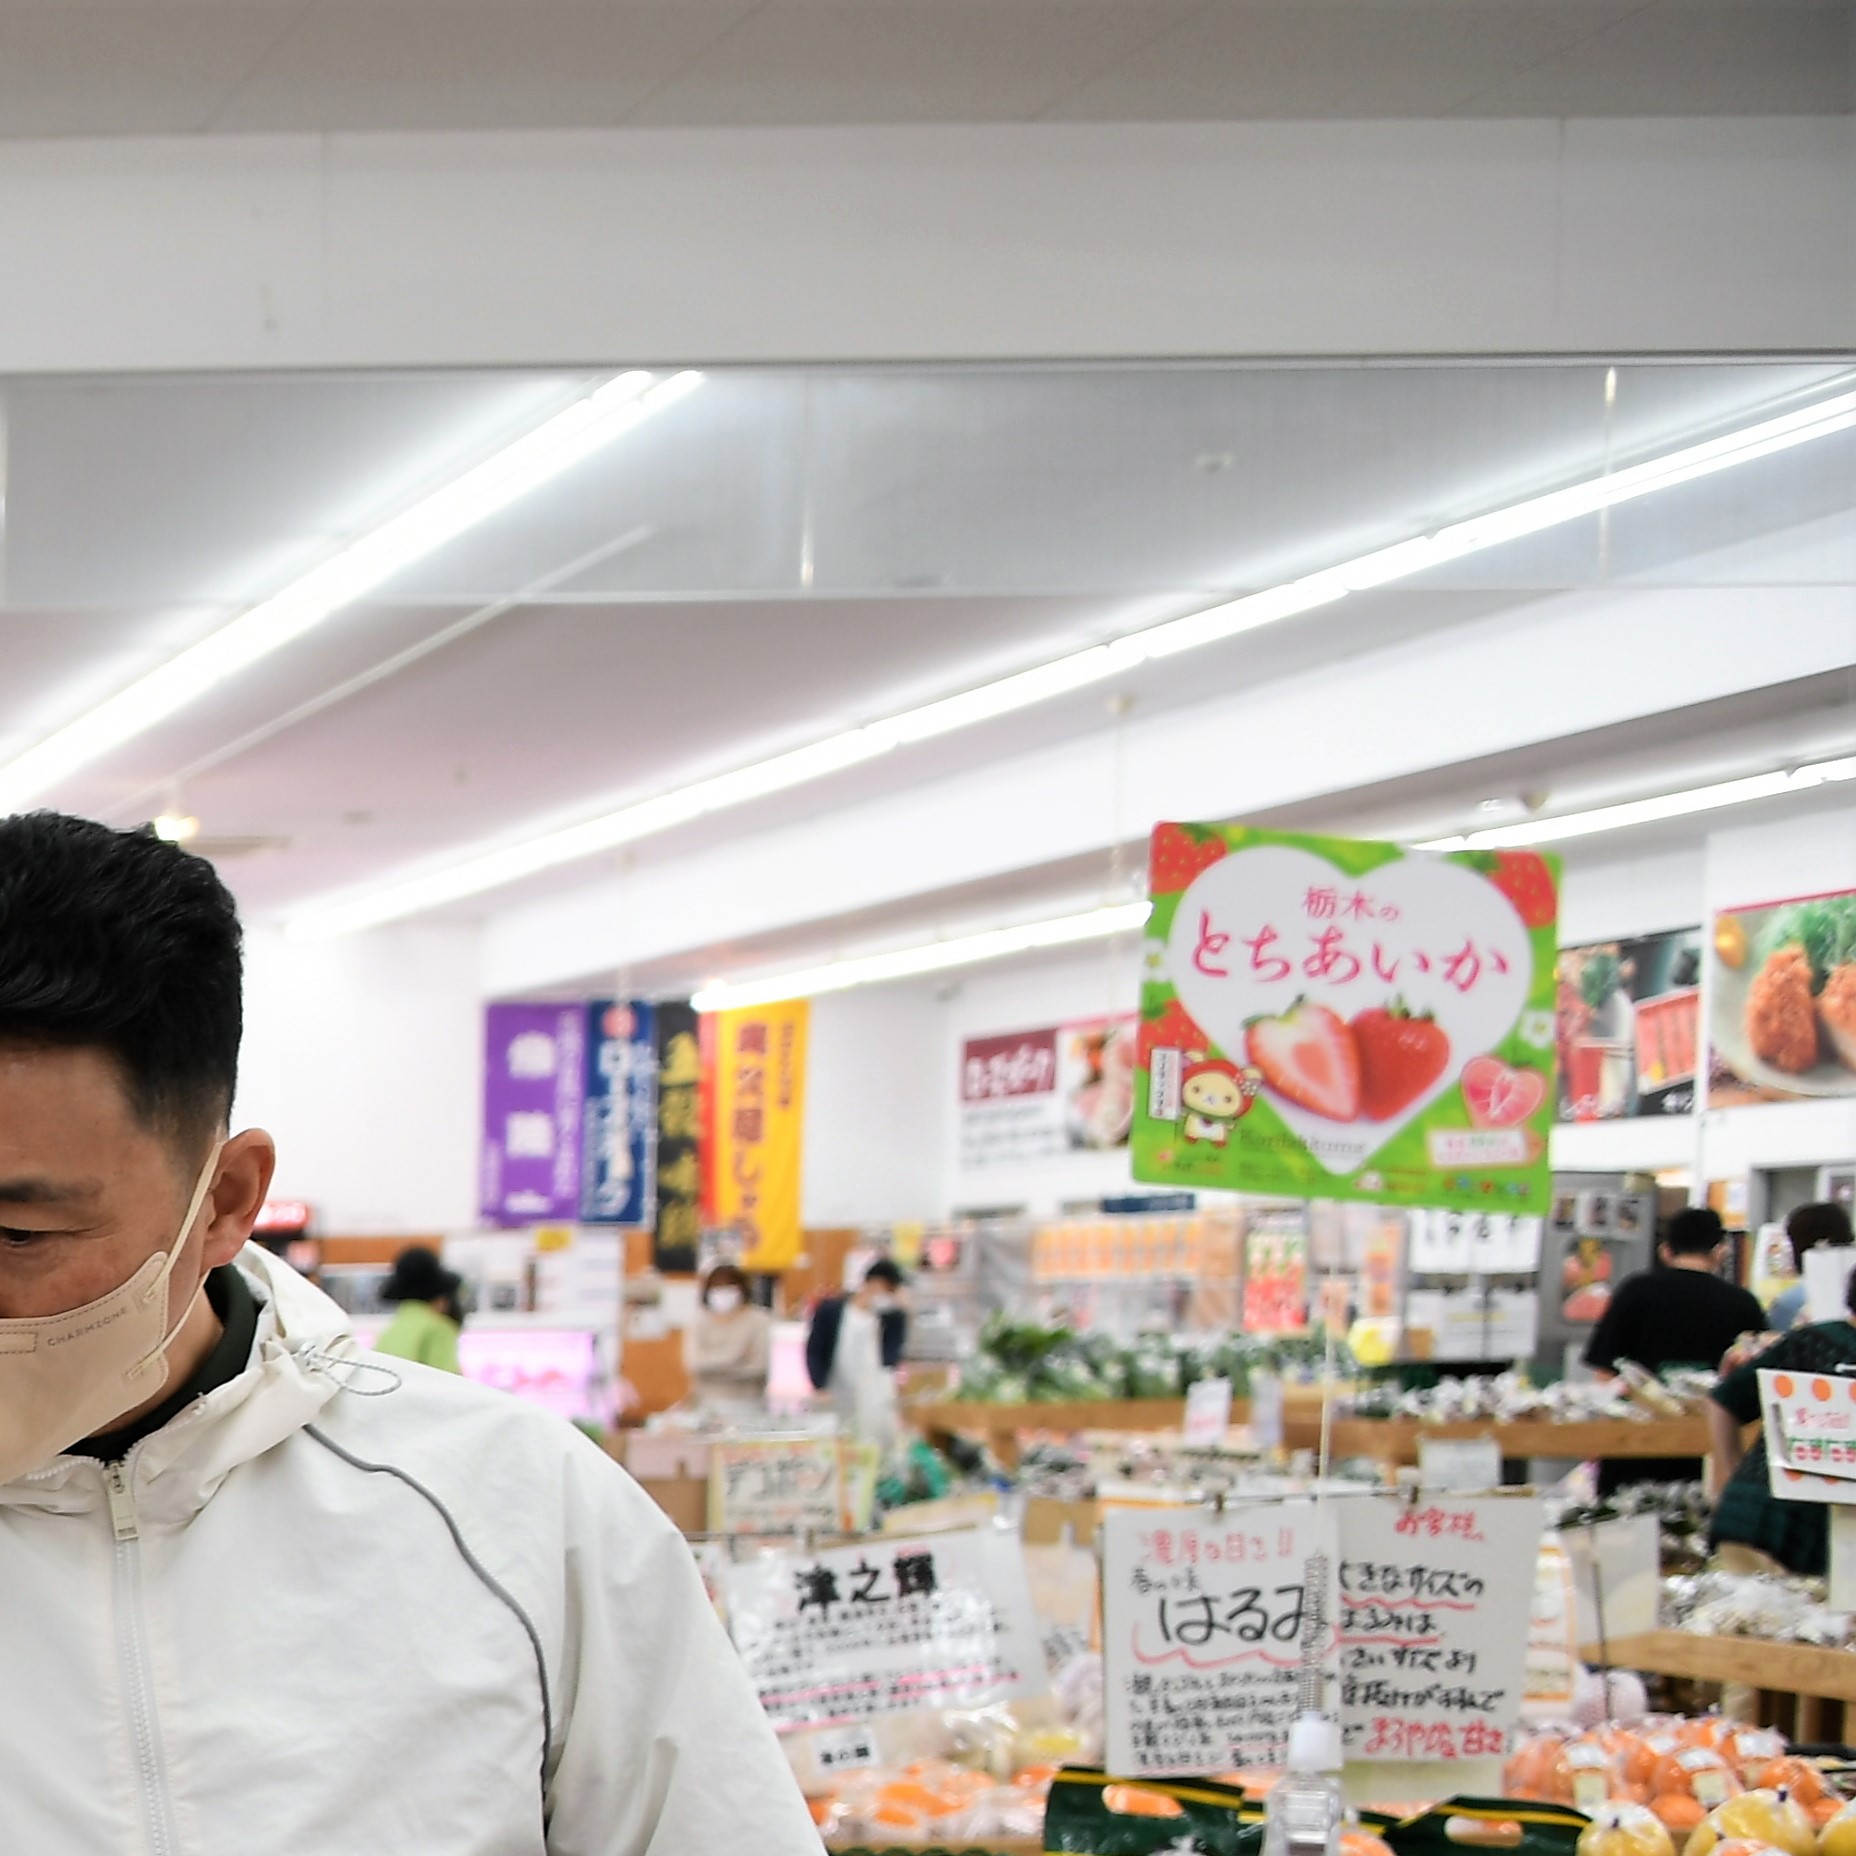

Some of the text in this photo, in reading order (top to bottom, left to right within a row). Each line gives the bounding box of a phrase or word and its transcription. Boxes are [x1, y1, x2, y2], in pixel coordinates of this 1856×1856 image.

[1191, 910, 1511, 993] とちあいか
